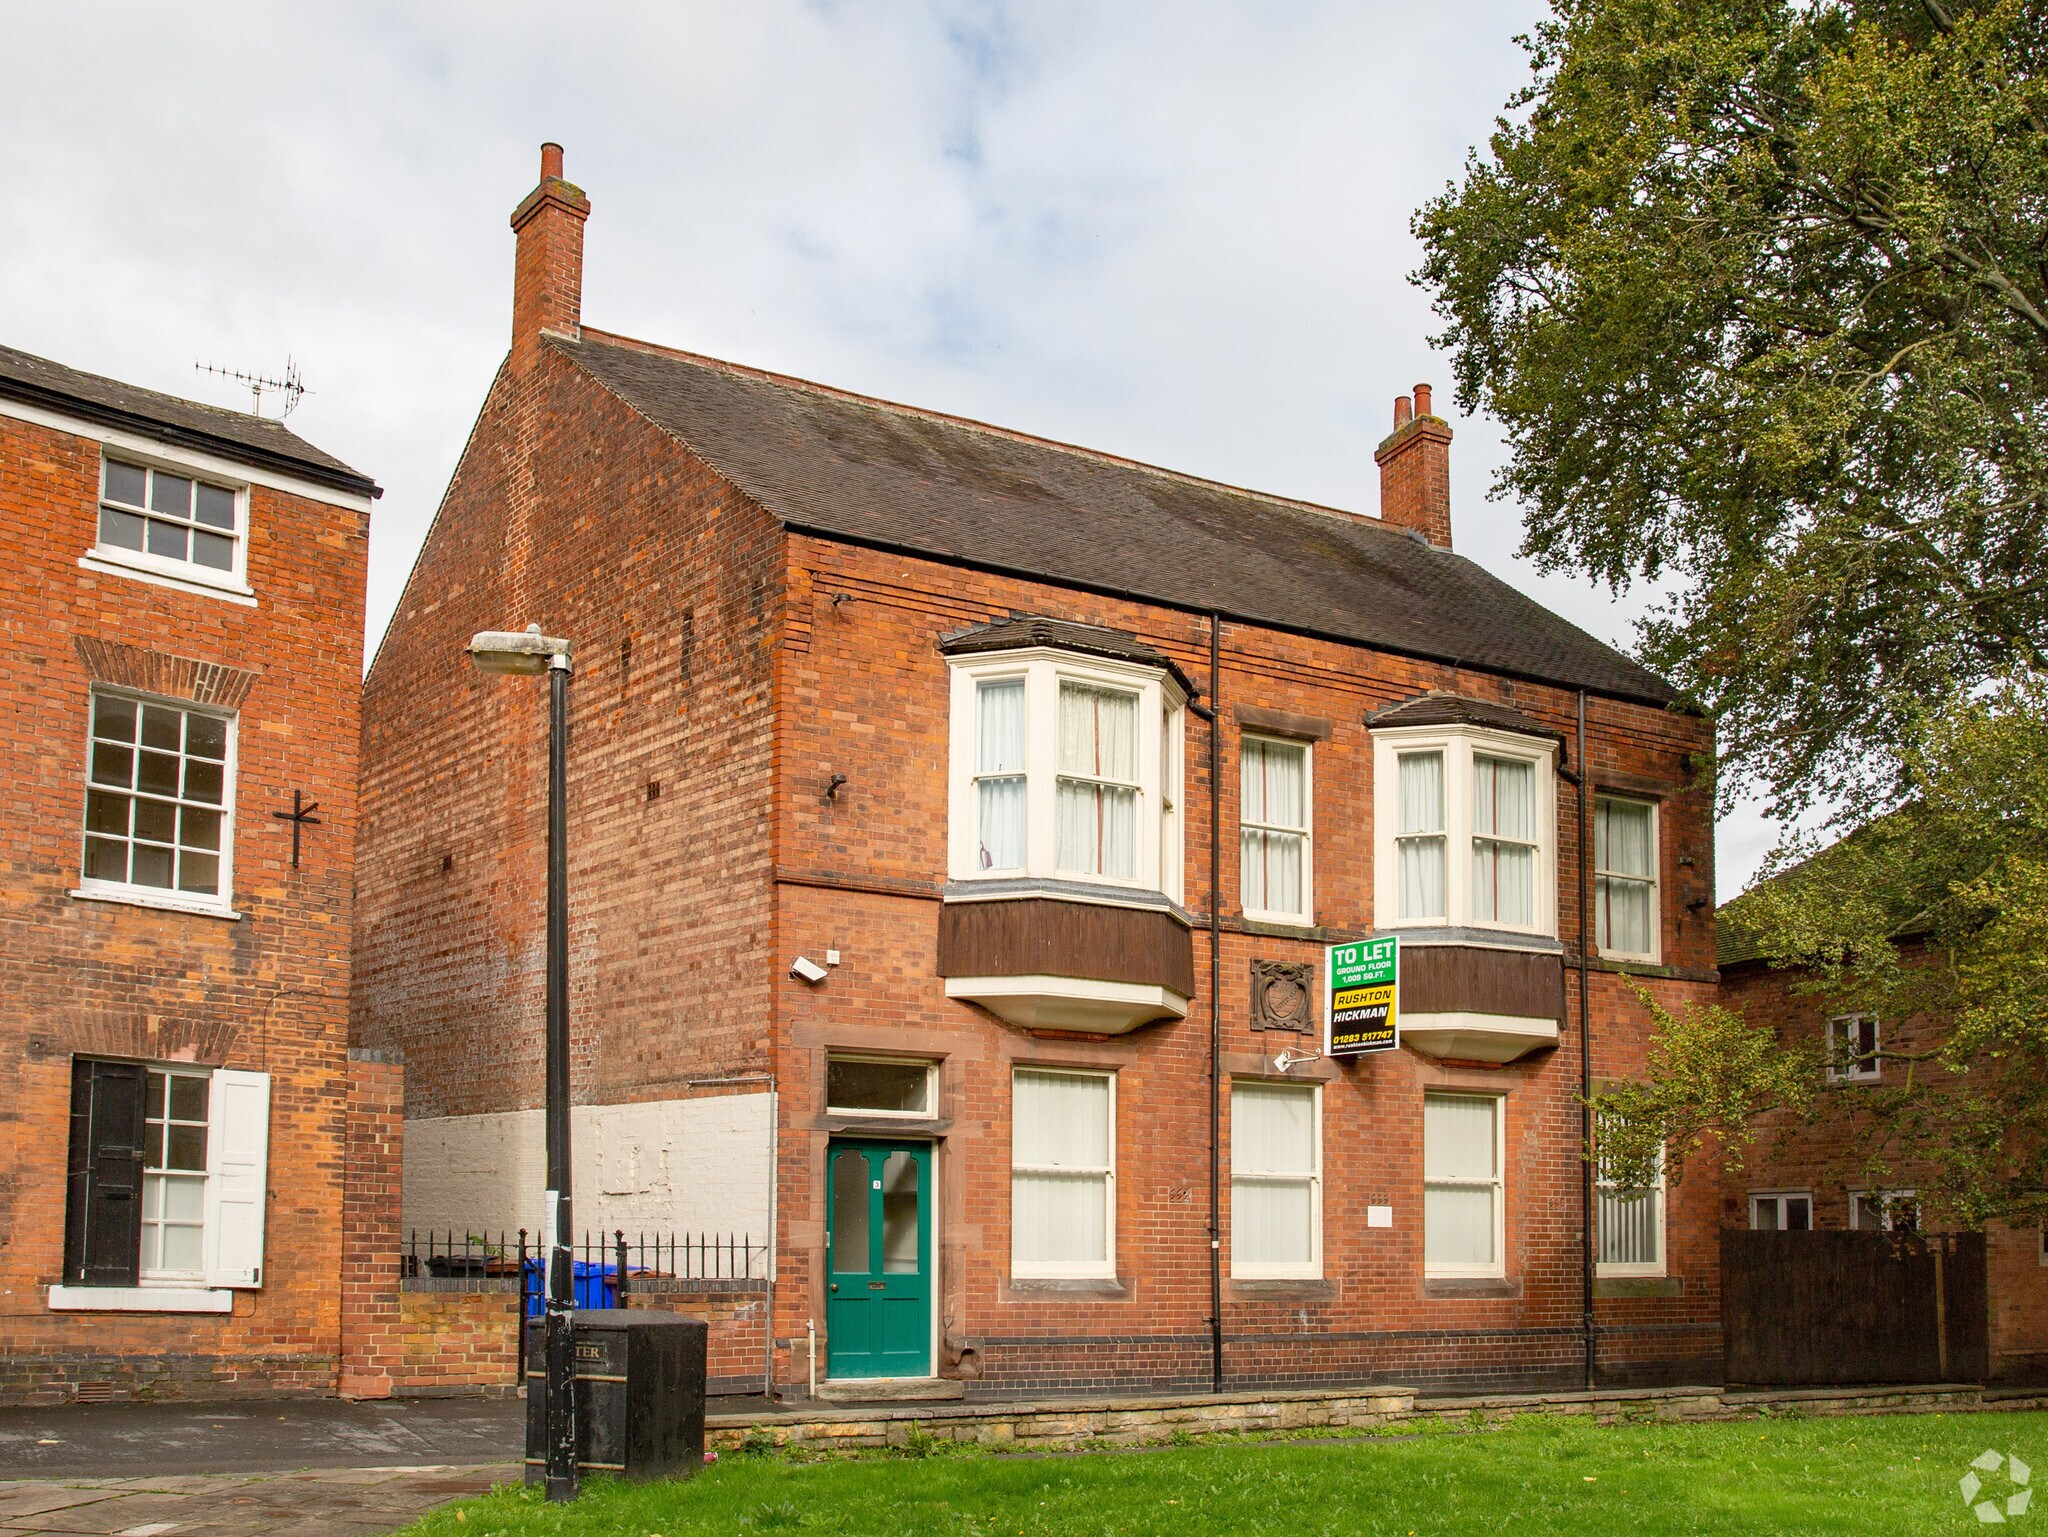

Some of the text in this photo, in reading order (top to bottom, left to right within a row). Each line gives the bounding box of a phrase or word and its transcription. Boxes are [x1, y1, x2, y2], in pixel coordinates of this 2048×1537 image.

[1334, 941, 1394, 966] TO LET
[1336, 960, 1391, 975] GROUND FLOOR
[1342, 974, 1361, 984] 1,009
[1338, 990, 1391, 1005] RUSHTON
[1333, 1006, 1388, 1023] HICKMAN
[1333, 1030, 1393, 1044] 01283 517747
[575, 1346, 600, 1358] TER
